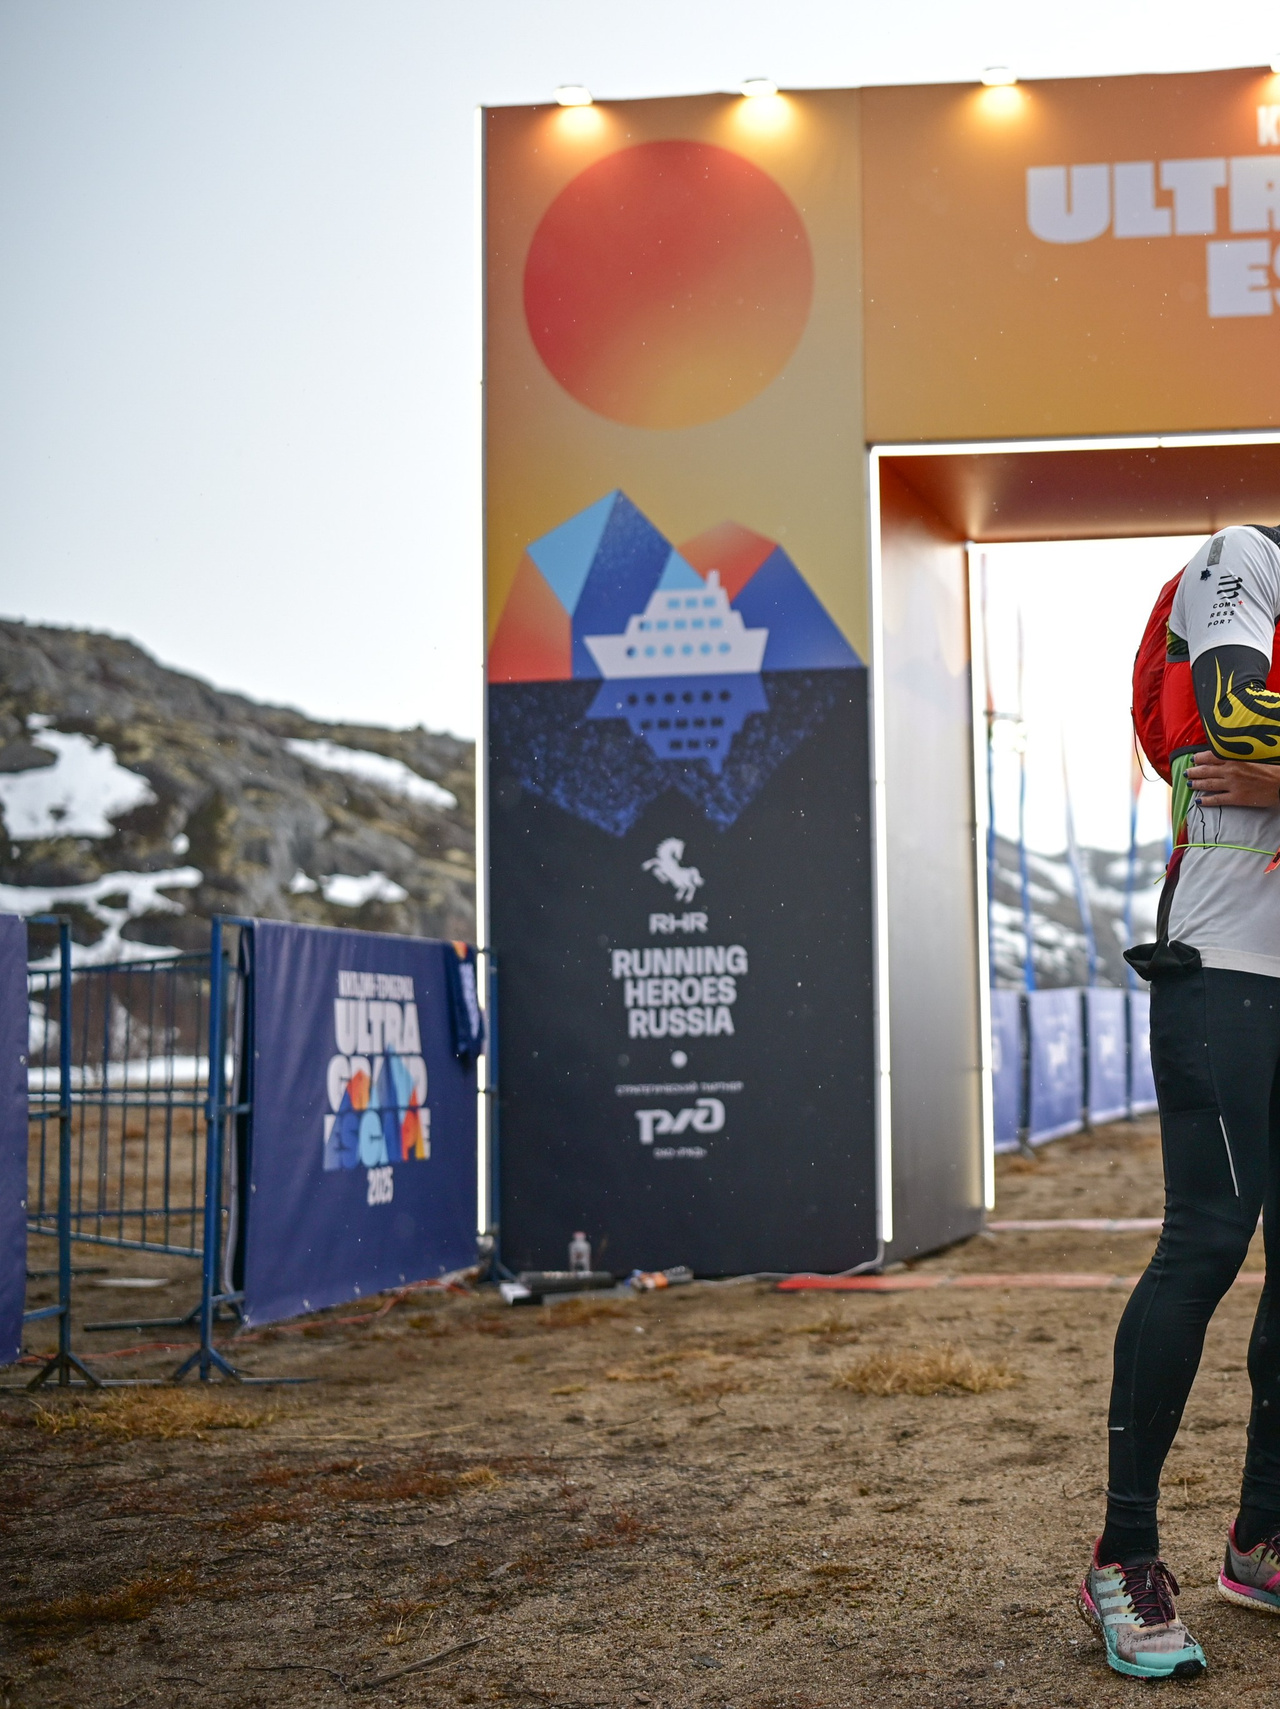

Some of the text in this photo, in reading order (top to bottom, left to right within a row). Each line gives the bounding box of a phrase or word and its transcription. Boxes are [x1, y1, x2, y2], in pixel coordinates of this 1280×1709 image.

[1207, 618, 1232, 628] PORT
[649, 911, 709, 935] RHR
[611, 944, 749, 981] RUNNING
[623, 975, 738, 1009] HEROES
[334, 997, 422, 1057] ULTRA
[627, 1005, 736, 1039] RUSSIA
[323, 1107, 431, 1172] ESCAPE
